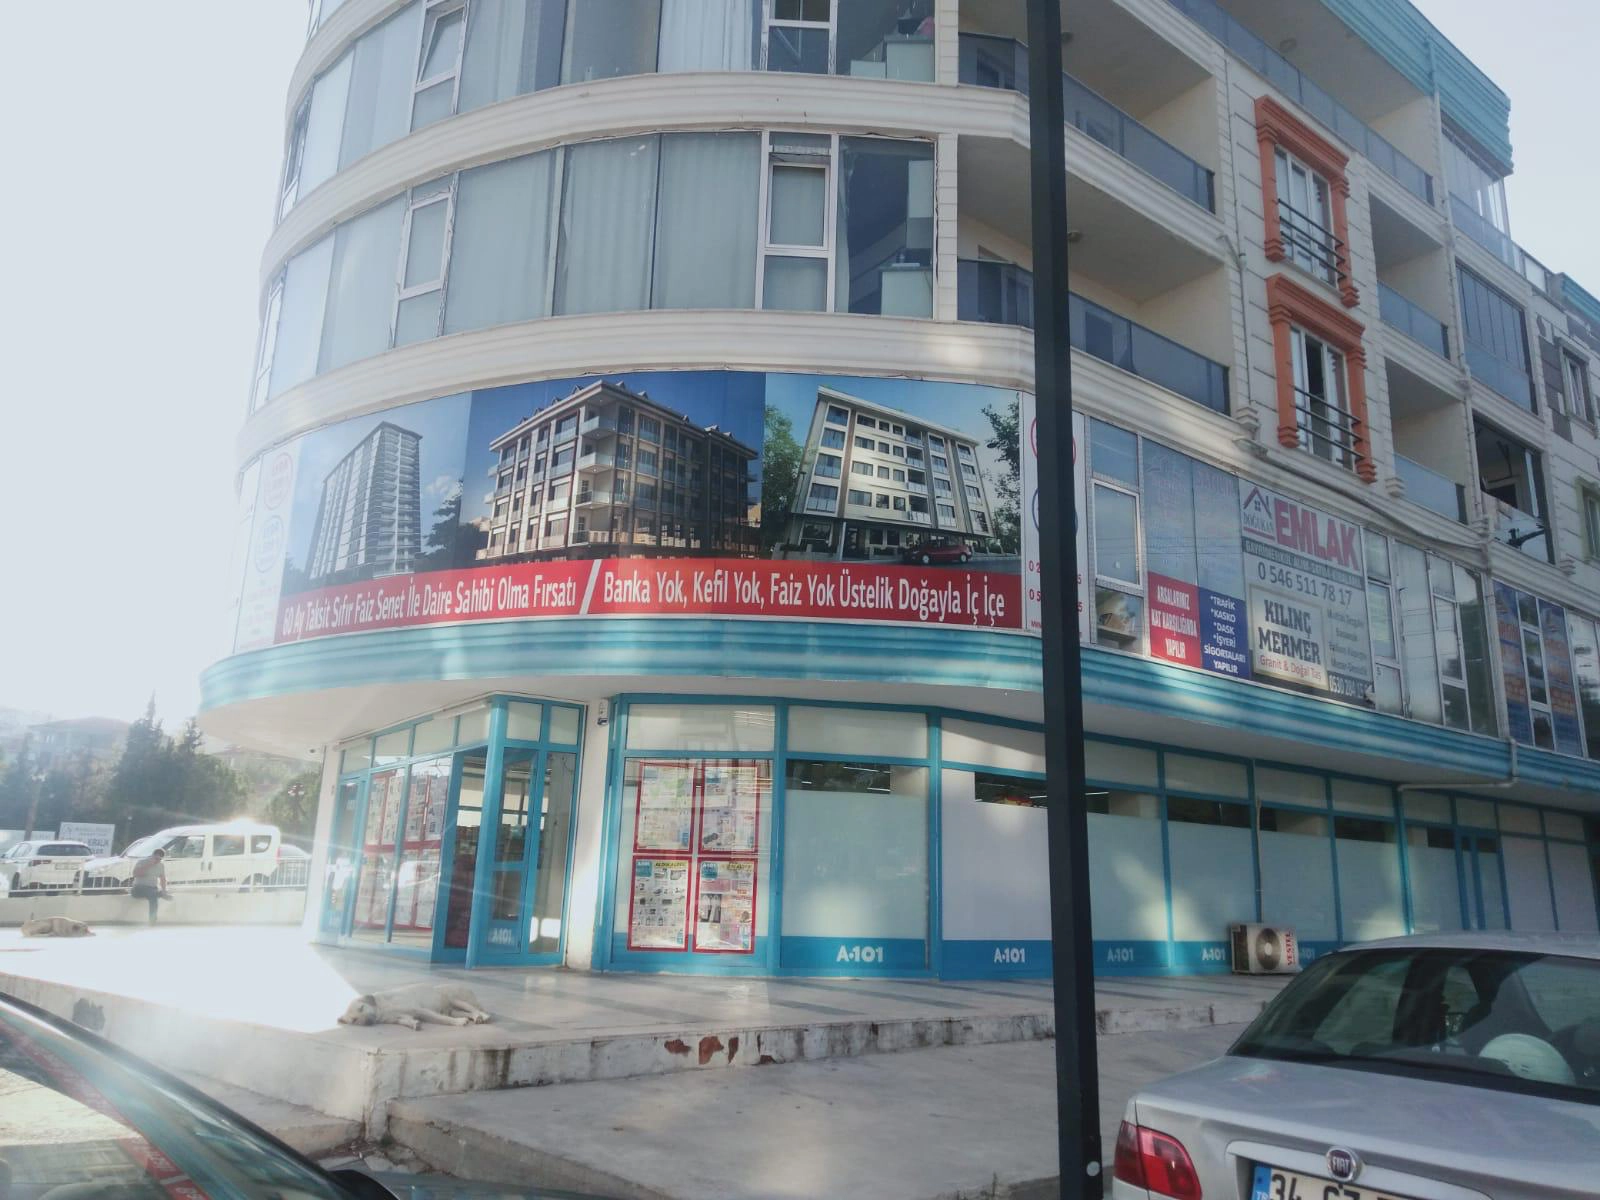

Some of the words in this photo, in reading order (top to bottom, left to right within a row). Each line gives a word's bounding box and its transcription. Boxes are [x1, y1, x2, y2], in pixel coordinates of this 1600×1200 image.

[1275, 499, 1359, 571] EMLAK
[603, 570, 651, 604] Banka
[656, 570, 688, 609] Yok,
[693, 569, 728, 604] Kefil
[733, 571, 765, 610] Yok,
[770, 573, 802, 606] Faiz
[807, 573, 835, 608] Yok
[839, 568, 894, 610] Üstelik
[899, 578, 962, 622] Doğayla
[966, 573, 980, 626] İç
[984, 574, 1006, 628] İçe
[1258, 562, 1266, 580] 0
[1270, 566, 1293, 592] 546
[1296, 575, 1318, 597] 511
[1321, 582, 1336, 602] 78
[1338, 589, 1352, 608] 17
[293, 603, 306, 640] Ay
[305, 597, 330, 631] Taksit
[331, 594, 354, 627] Sıfır
[354, 591, 375, 624] Faiz
[376, 588, 405, 620] Senet
[407, 577, 420, 617] İle
[422, 583, 452, 614] Daire
[455, 577, 495, 614] Sahibi
[498, 576, 529, 609] Olma
[533, 574, 577, 608] Fırsatı
[1264, 599, 1312, 639] KILINÇ
[1257, 627, 1322, 665] MERMER
[1260, 654, 1282, 671] Granit
[1284, 930, 1294, 966] VESTEL
[1332, 1155, 1351, 1173] FIAT
